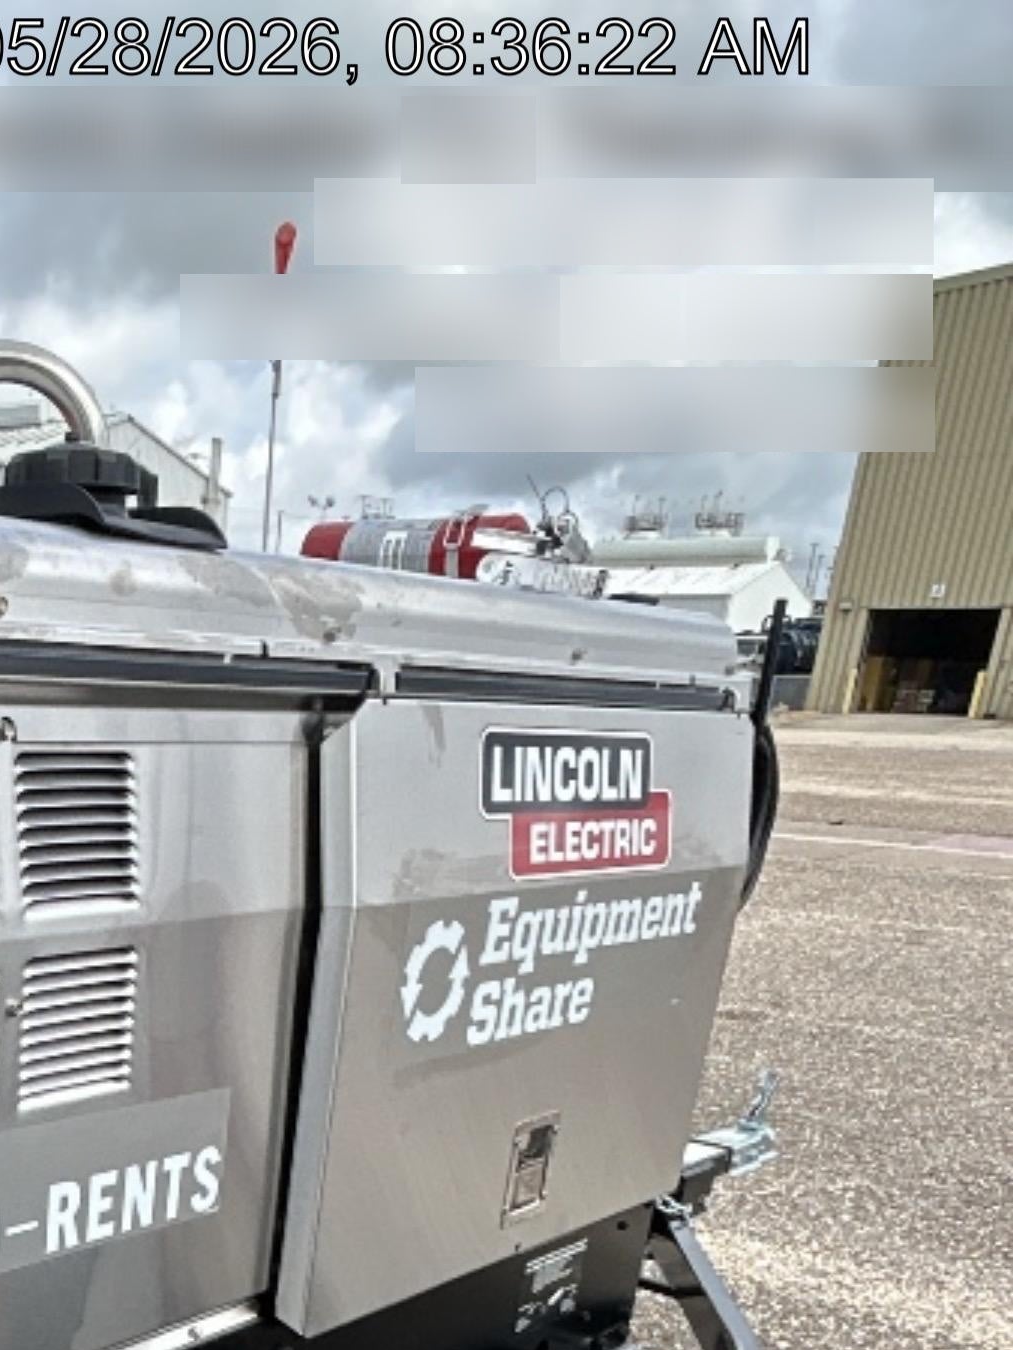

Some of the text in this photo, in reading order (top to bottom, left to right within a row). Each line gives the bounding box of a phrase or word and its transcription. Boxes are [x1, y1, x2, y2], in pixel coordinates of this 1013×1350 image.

[491, 746, 644, 802] LINCOLN
[529, 818, 658, 864] ELECTRIC
[479, 881, 702, 974] Equipment
[466, 977, 594, 1046] Share
